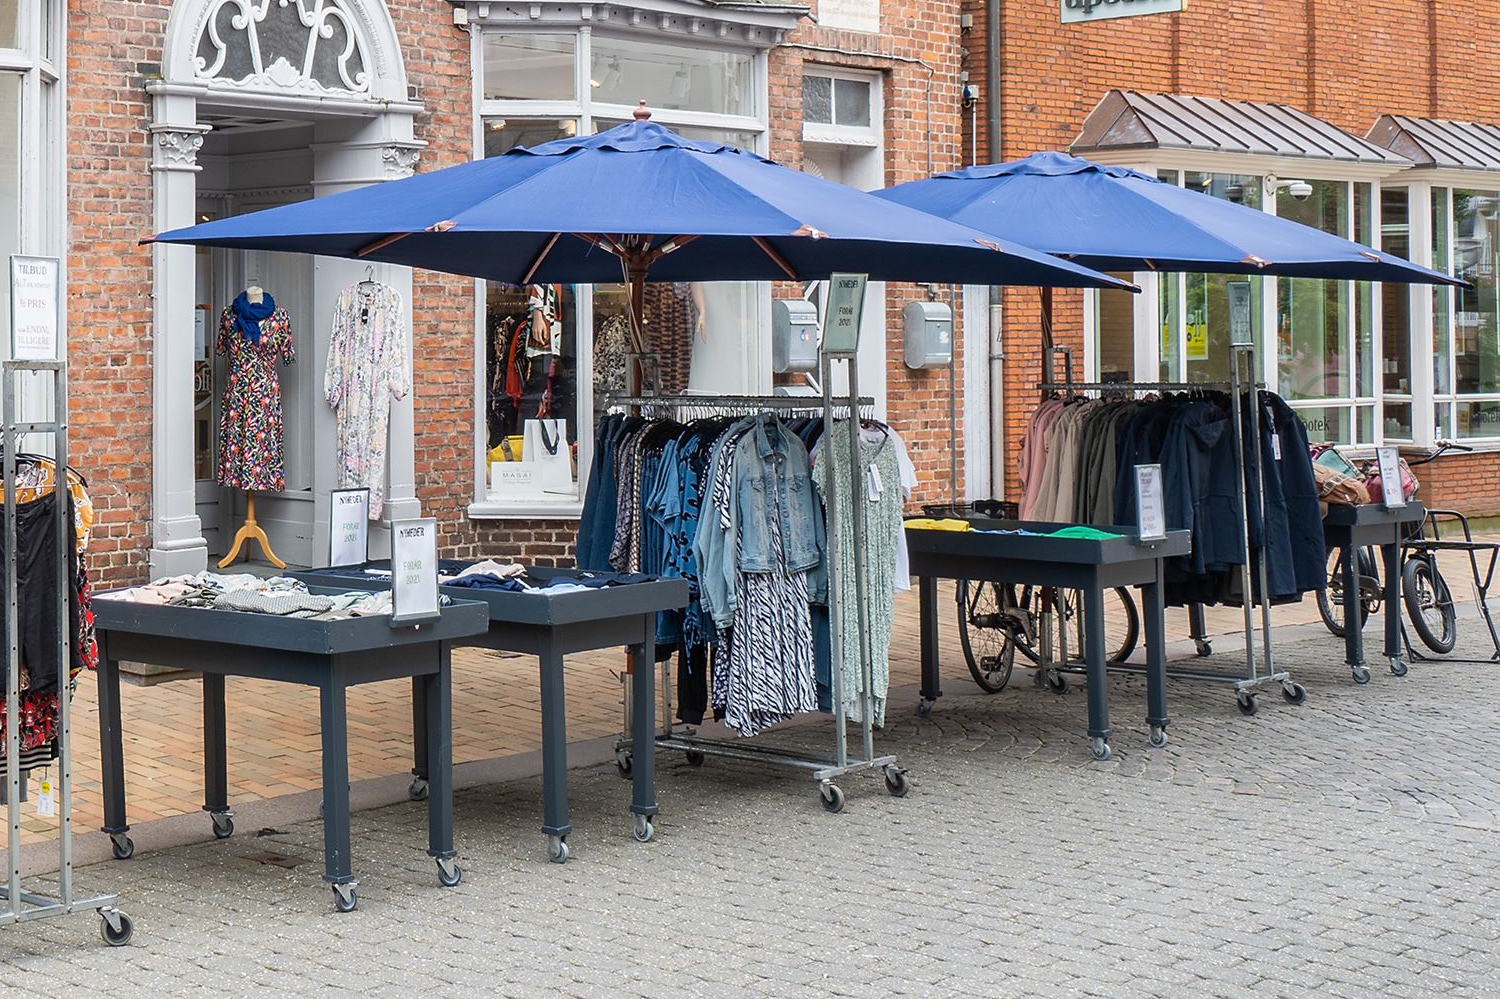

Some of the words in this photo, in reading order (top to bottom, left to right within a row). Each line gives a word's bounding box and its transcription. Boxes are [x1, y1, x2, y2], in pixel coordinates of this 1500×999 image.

[19, 264, 48, 275] TILBUD
[27, 299, 46, 309] PRIS
[1302, 416, 1332, 432] otek
[399, 527, 425, 538] NYHEDER
